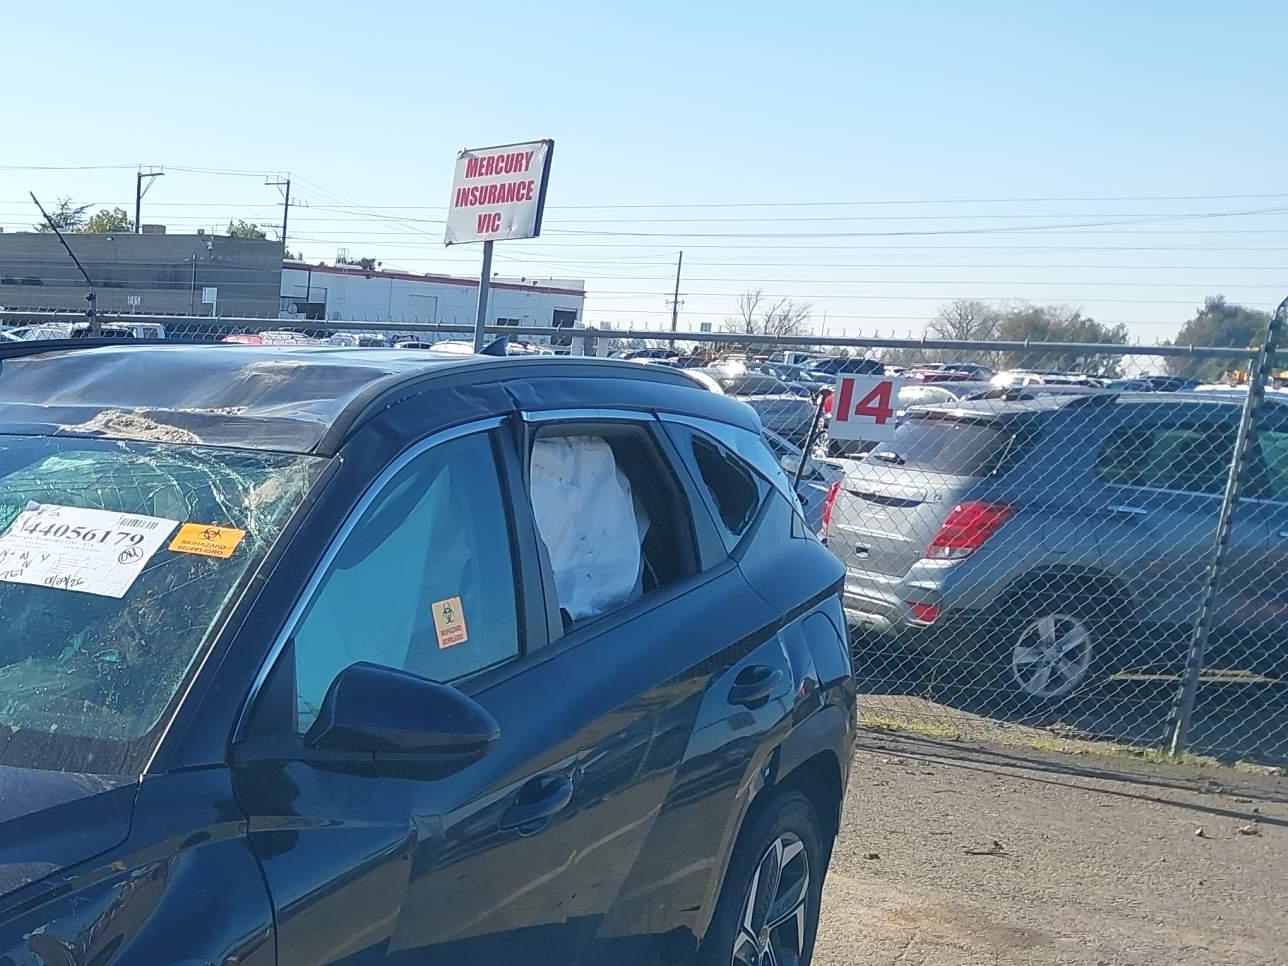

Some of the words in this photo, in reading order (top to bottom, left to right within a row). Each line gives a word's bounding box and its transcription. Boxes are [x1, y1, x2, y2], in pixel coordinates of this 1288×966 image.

[465, 151, 535, 178] MERCURY
[455, 180, 535, 208] INSURANCE
[477, 212, 502, 234] VIC
[836, 378, 894, 425] 14
[23, 520, 145, 548] 44056179
